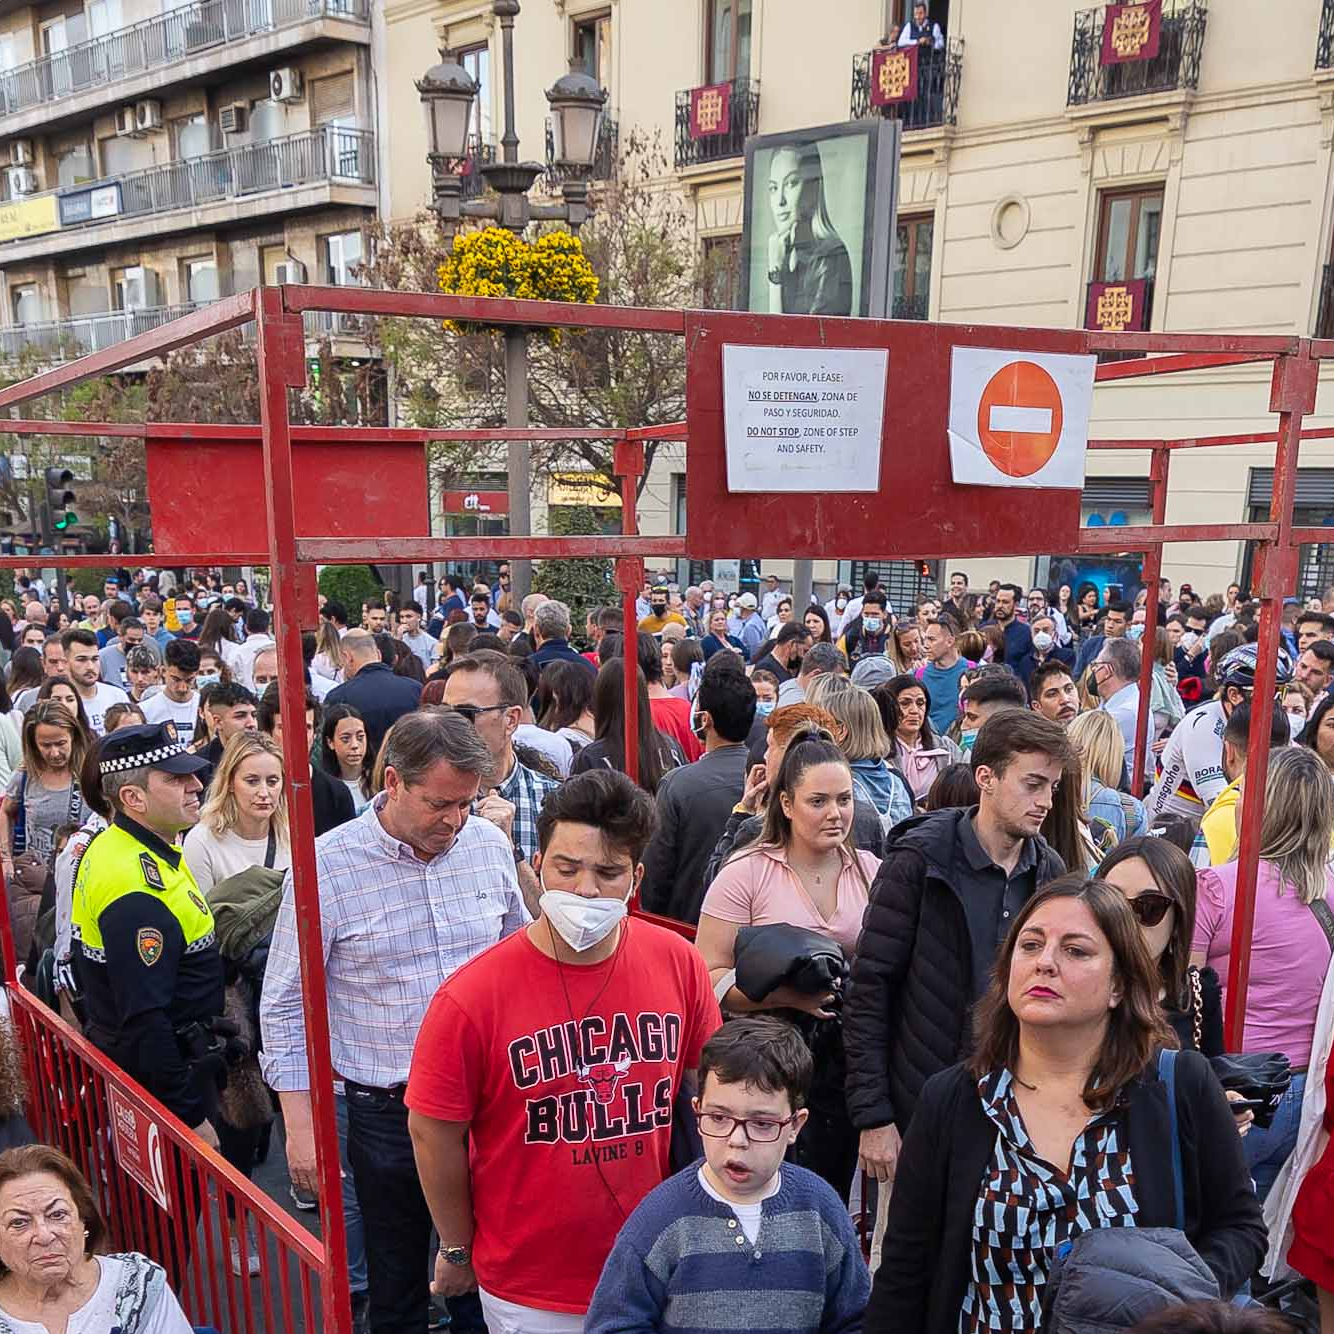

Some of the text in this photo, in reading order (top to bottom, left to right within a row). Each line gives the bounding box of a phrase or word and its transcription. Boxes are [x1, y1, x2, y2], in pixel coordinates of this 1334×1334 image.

[762, 371, 844, 383] POR FAVOR, PLEASE:
[748, 390, 761, 401] NO
[762, 391, 772, 401] SE
[821, 391, 845, 401] ZONA
[846, 392, 858, 401] DE
[763, 408, 841, 418] PASO Y SEGURIDAD.
[747, 426, 759, 436] DO
[760, 427, 777, 436] NOT
[803, 427, 825, 437] ZONE
[826, 427, 838, 437] OF
[839, 427, 859, 437] STEP
[777, 444, 826, 454] AND SAFETY.
[1153, 764, 1180, 814] hansgrohe
[507, 1012, 682, 1090] CHICAGO
[524, 1076, 673, 1145] BULLS
[572, 1140, 644, 1165] LAVINE 8
